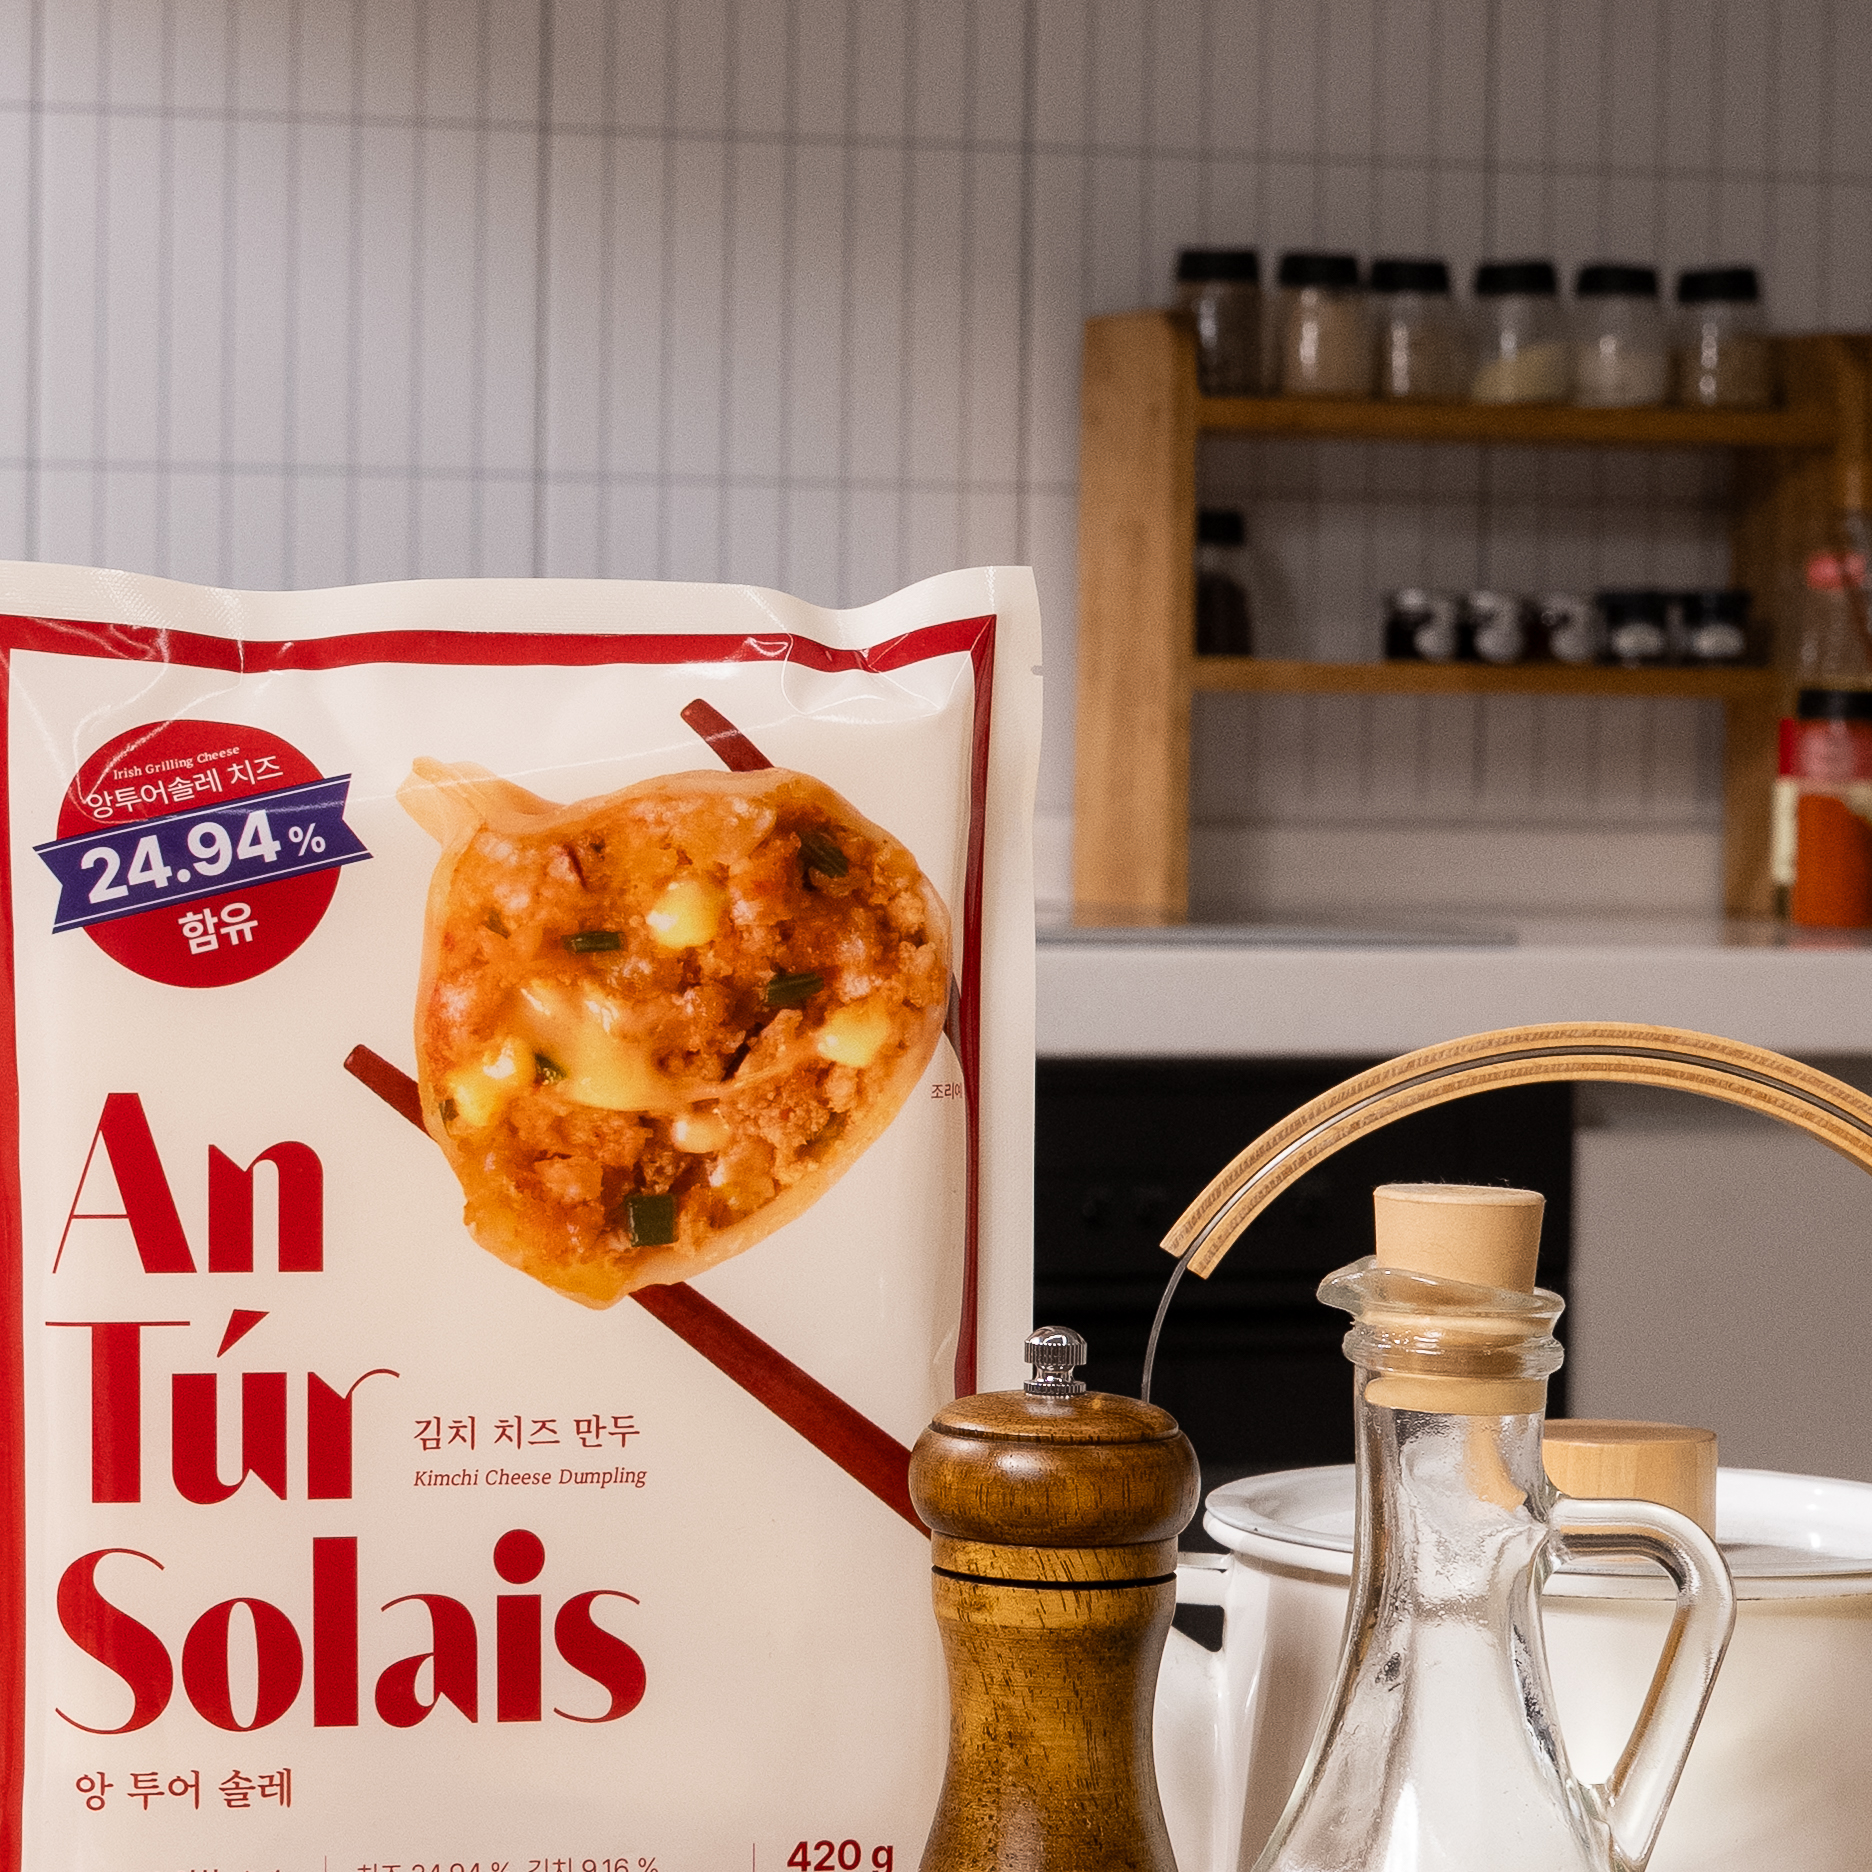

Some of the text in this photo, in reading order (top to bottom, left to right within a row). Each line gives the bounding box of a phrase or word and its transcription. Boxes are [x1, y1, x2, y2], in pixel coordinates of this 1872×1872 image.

[85, 755, 284, 820] 앙투어솔레 치즈
[113, 744, 241, 780] Irish Grilling Cheese
[80, 809, 326, 904] 24.94 %
[178, 900, 259, 955] 함유
[52, 1092, 324, 1274] An
[45, 1308, 400, 1505] Túr
[413, 1413, 640, 1451] 김치 치즈 만두
[413, 1466, 648, 1489] Kimchi Cheese Dumpling
[55, 1528, 647, 1735] Solais
[74, 1767, 293, 1811] 앙 투어 솔레
[786, 1839, 862, 1872] 420
